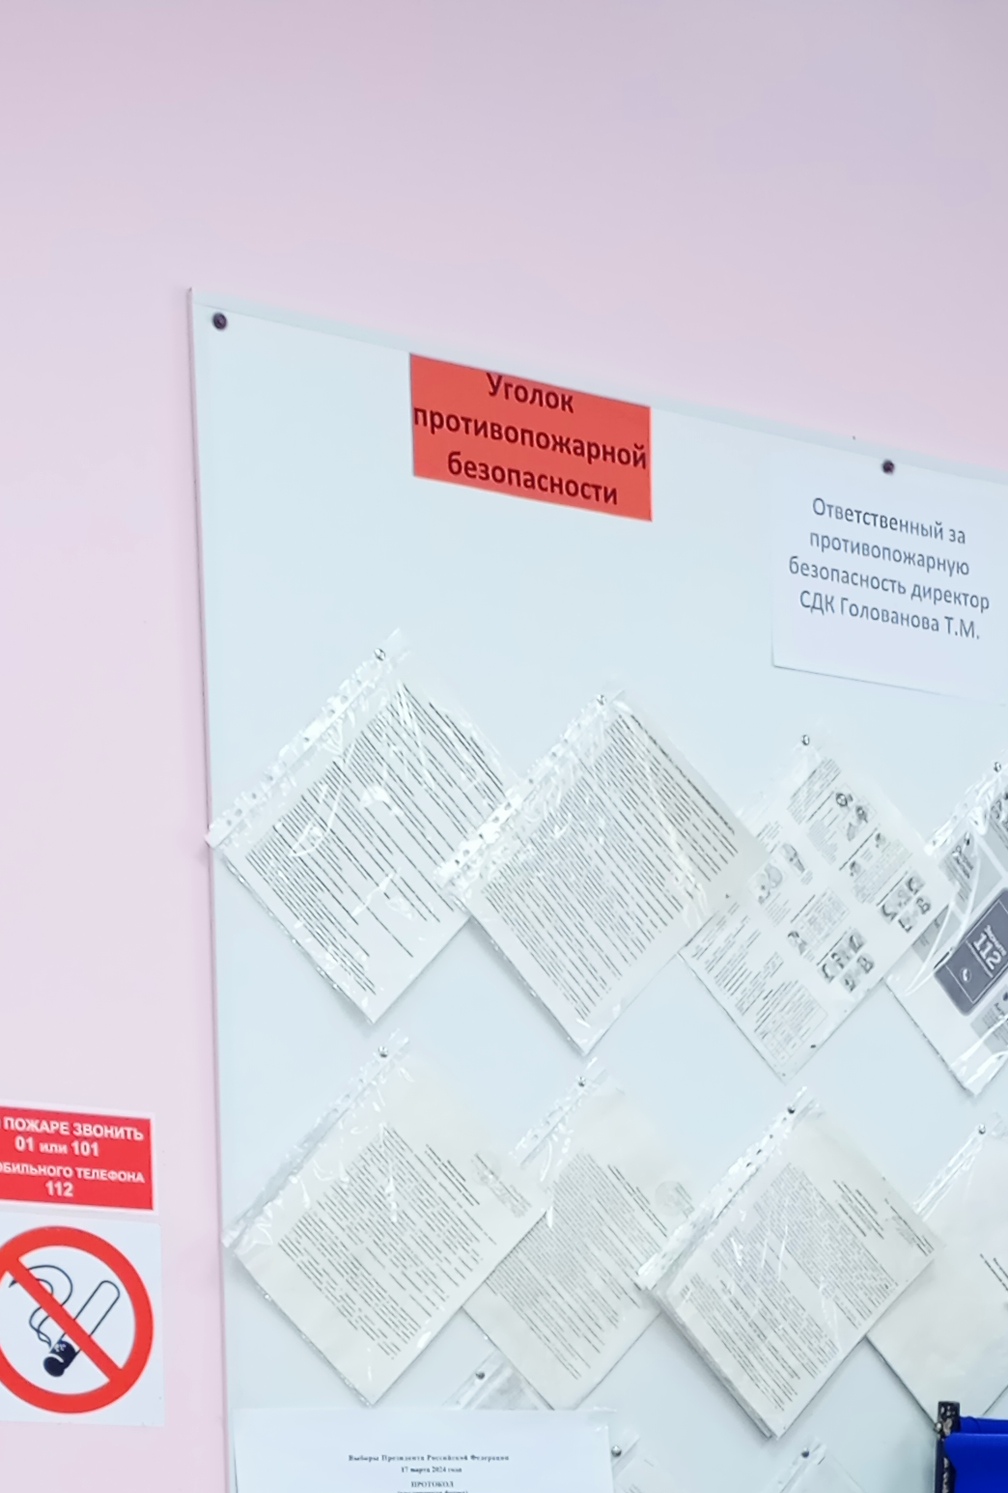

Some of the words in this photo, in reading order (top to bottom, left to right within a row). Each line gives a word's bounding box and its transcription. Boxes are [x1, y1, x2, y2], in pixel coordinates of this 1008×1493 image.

[486, 372, 574, 414] Уголок
[413, 406, 647, 470] противопожарной
[447, 451, 618, 505] безопасности
[812, 497, 944, 541] Ответственный
[948, 528, 966, 544] за
[810, 531, 970, 578] противопожарную
[789, 555, 907, 595] безопасность
[910, 583, 990, 614] директор
[799, 590, 836, 616] СДК
[840, 596, 940, 632] Голованова
[944, 615, 980, 640] Т.М.
[972, 932, 1002, 970] 112
[3, 1116, 70, 1136] ПОЖАРЕ
[72, 1122, 145, 1142] ЗВОНИТЬ
[15, 1135, 35, 1152] 01
[39, 1142, 69, 1154] или
[71, 1140, 100, 1158] 101
[0, 1161, 73, 1178] БИЛЬНОГО
[75, 1167, 146, 1184] ТЕЛЕФОНА
[45, 1180, 74, 1198] 112
